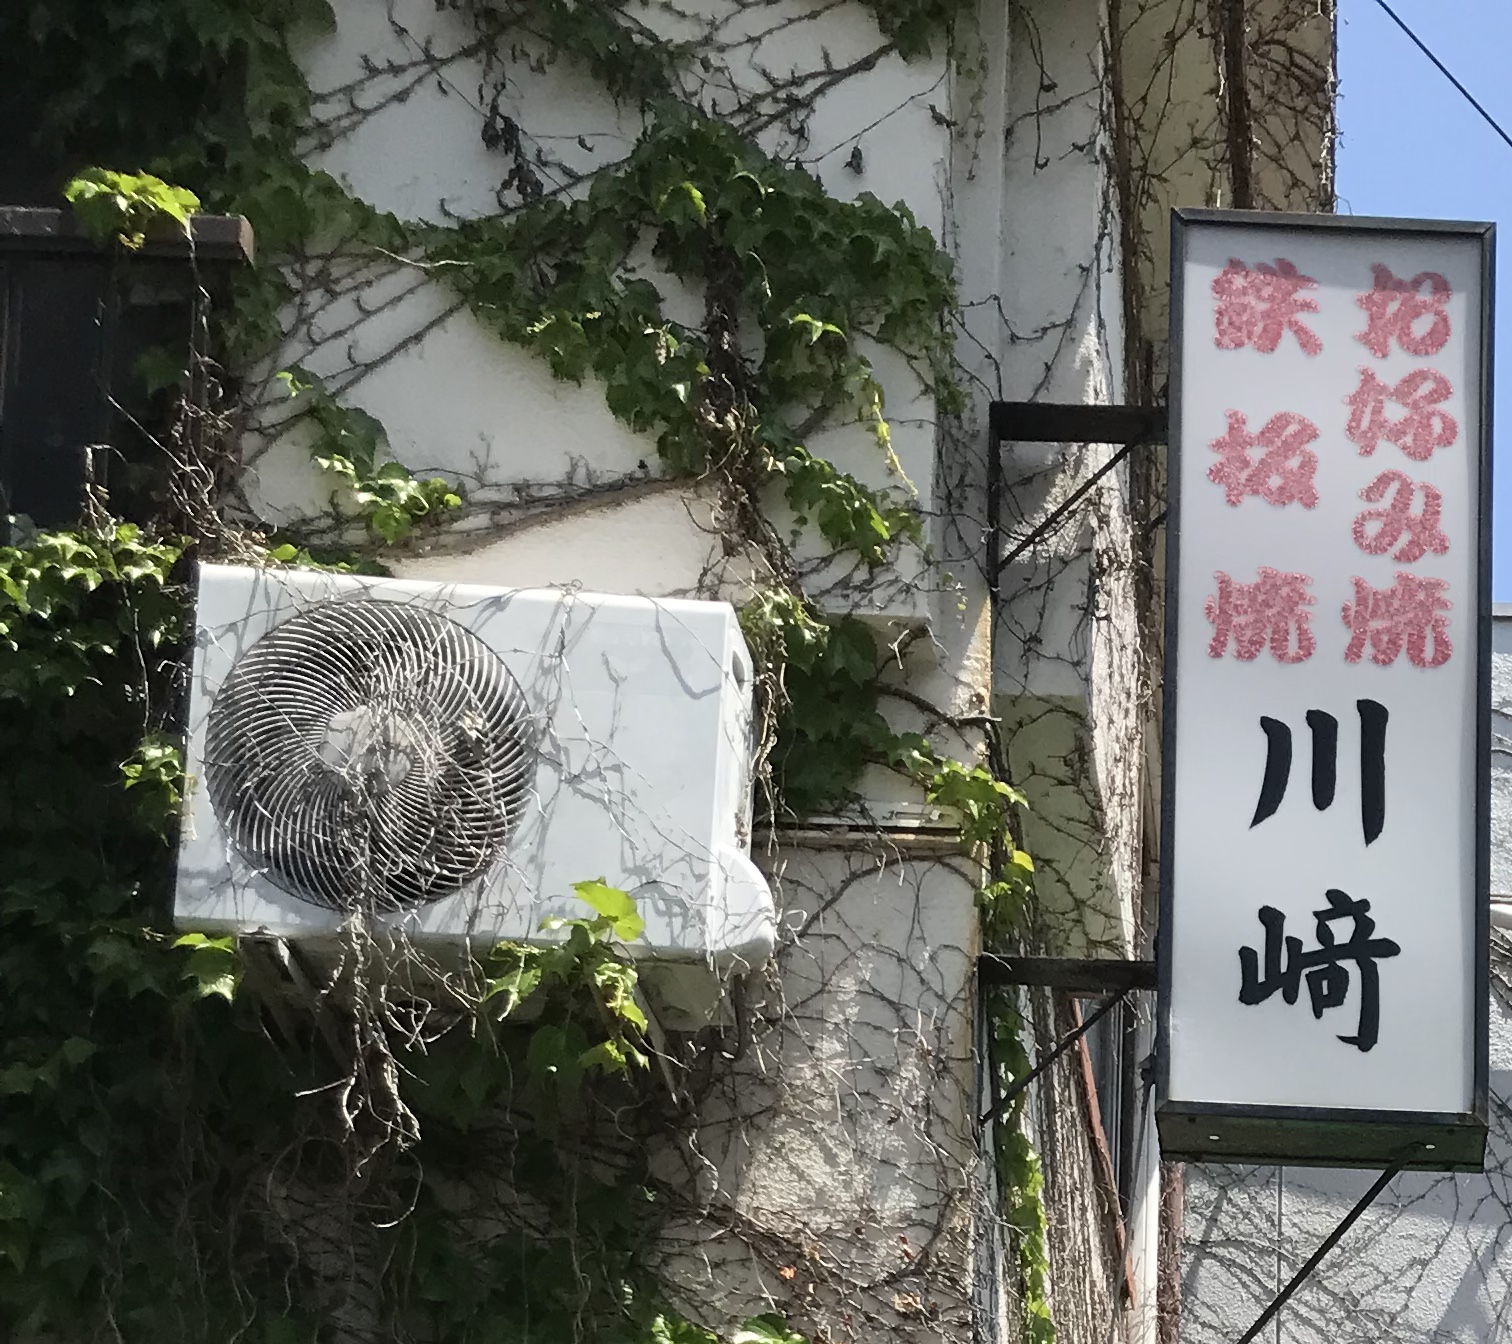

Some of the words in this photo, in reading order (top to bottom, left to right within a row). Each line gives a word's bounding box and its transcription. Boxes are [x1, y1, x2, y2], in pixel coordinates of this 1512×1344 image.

[1204, 257, 1323, 664] 鉄板焼
[1343, 262, 1458, 669] お好み焼
